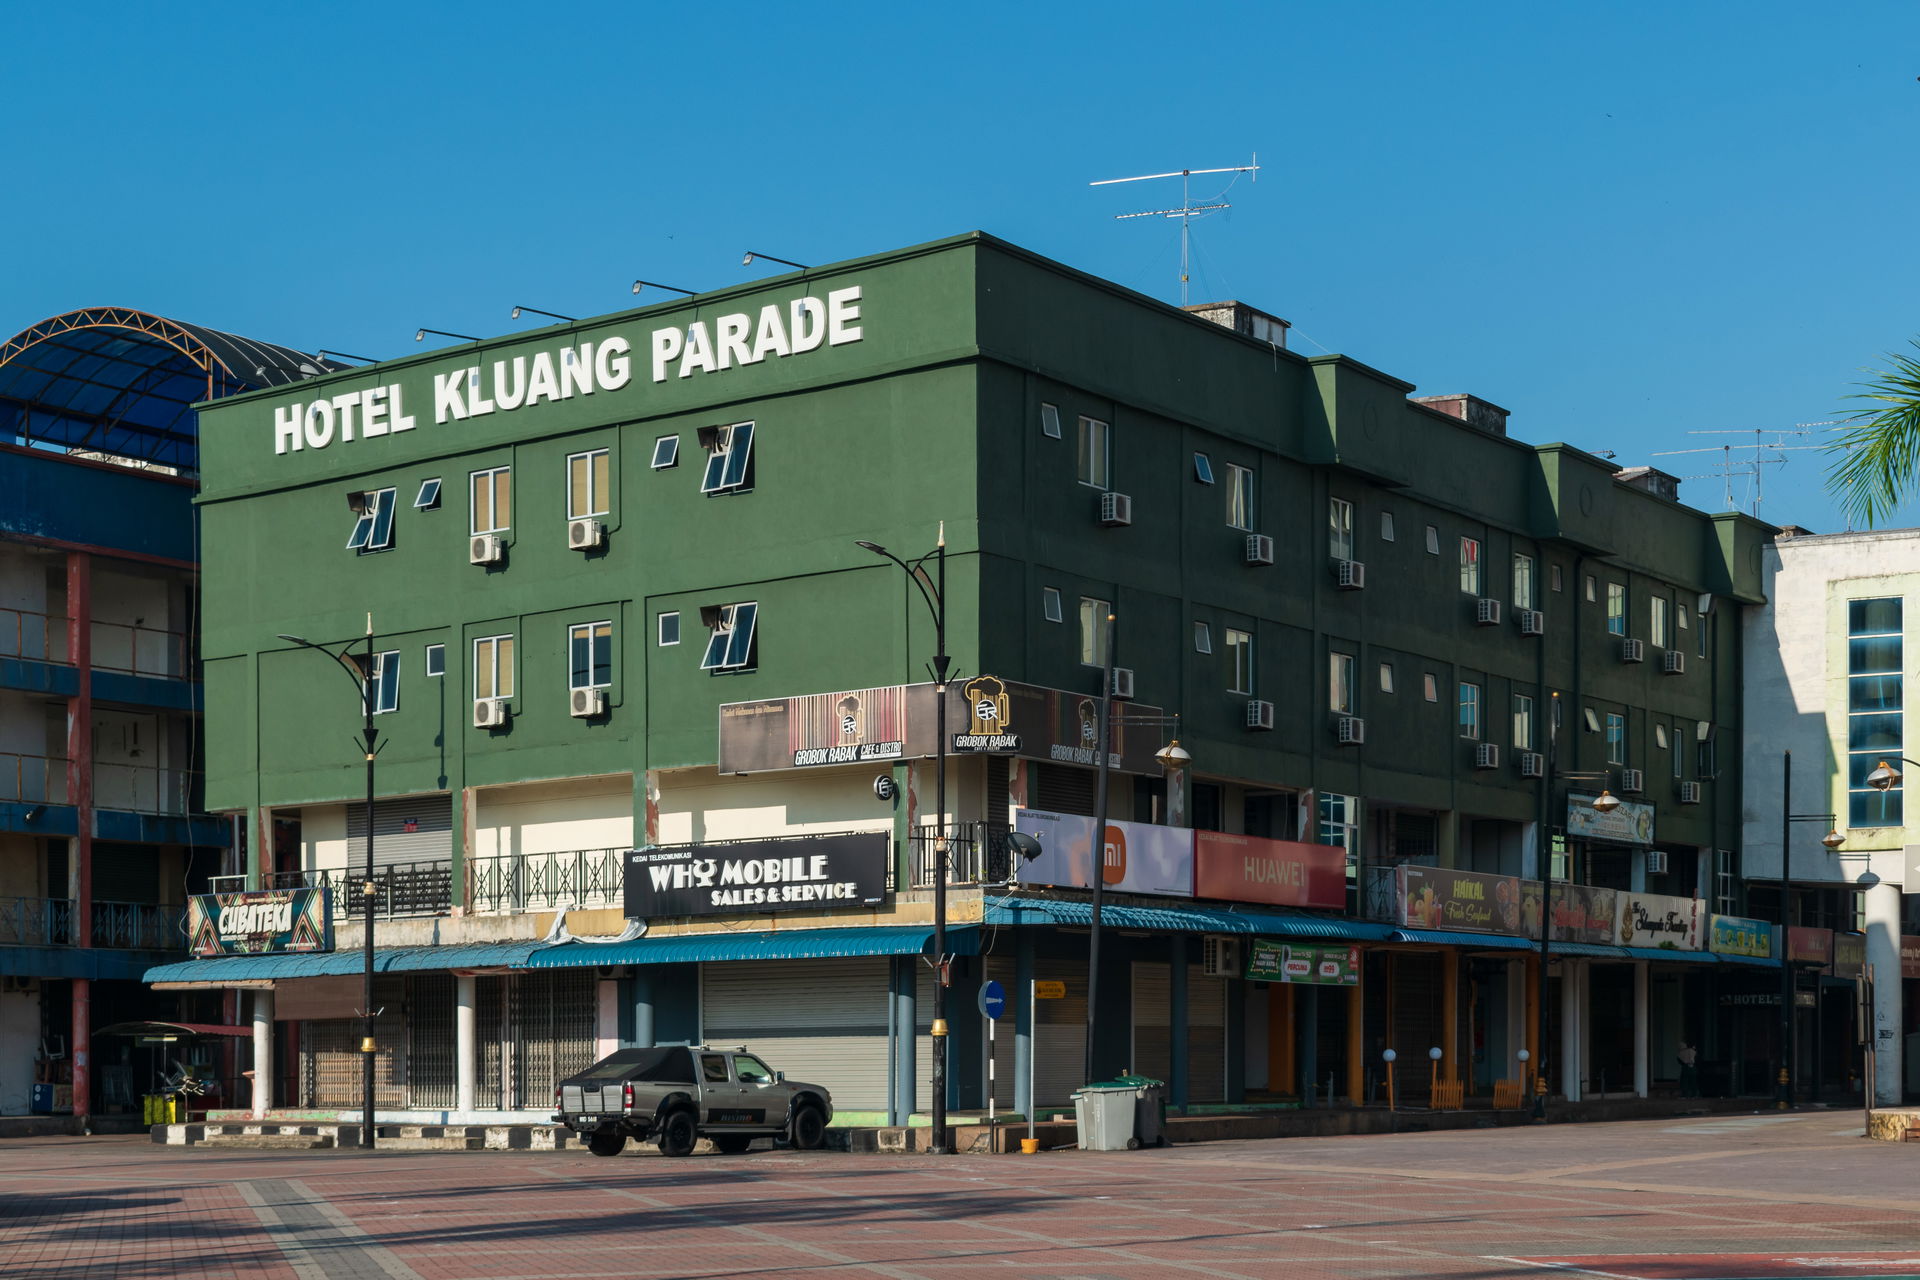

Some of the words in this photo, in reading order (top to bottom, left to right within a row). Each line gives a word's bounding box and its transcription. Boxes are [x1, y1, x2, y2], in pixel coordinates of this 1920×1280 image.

[274, 382, 417, 455] HOTEL
[434, 335, 631, 424] KLUANG
[651, 285, 864, 381] PARADE
[861, 744, 875, 755] CAFE
[956, 735, 989, 747] GROBOK
[989, 735, 1018, 747] RABAK
[795, 748, 828, 765] GROBOK
[829, 745, 857, 763] RABAK
[1051, 744, 1074, 762] GROBOK
[1073, 747, 1094, 765] RABAK
[632, 855, 647, 863] KEDAI
[649, 852, 692, 861] TELEKOMUNIKASI
[649, 858, 718, 892] WHY
[720, 855, 829, 886] MOBILE
[1244, 855, 1305, 887] HUAWEI
[218, 901, 293, 935] CUBATEKA
[1733, 994, 1773, 1005] HOTEL
